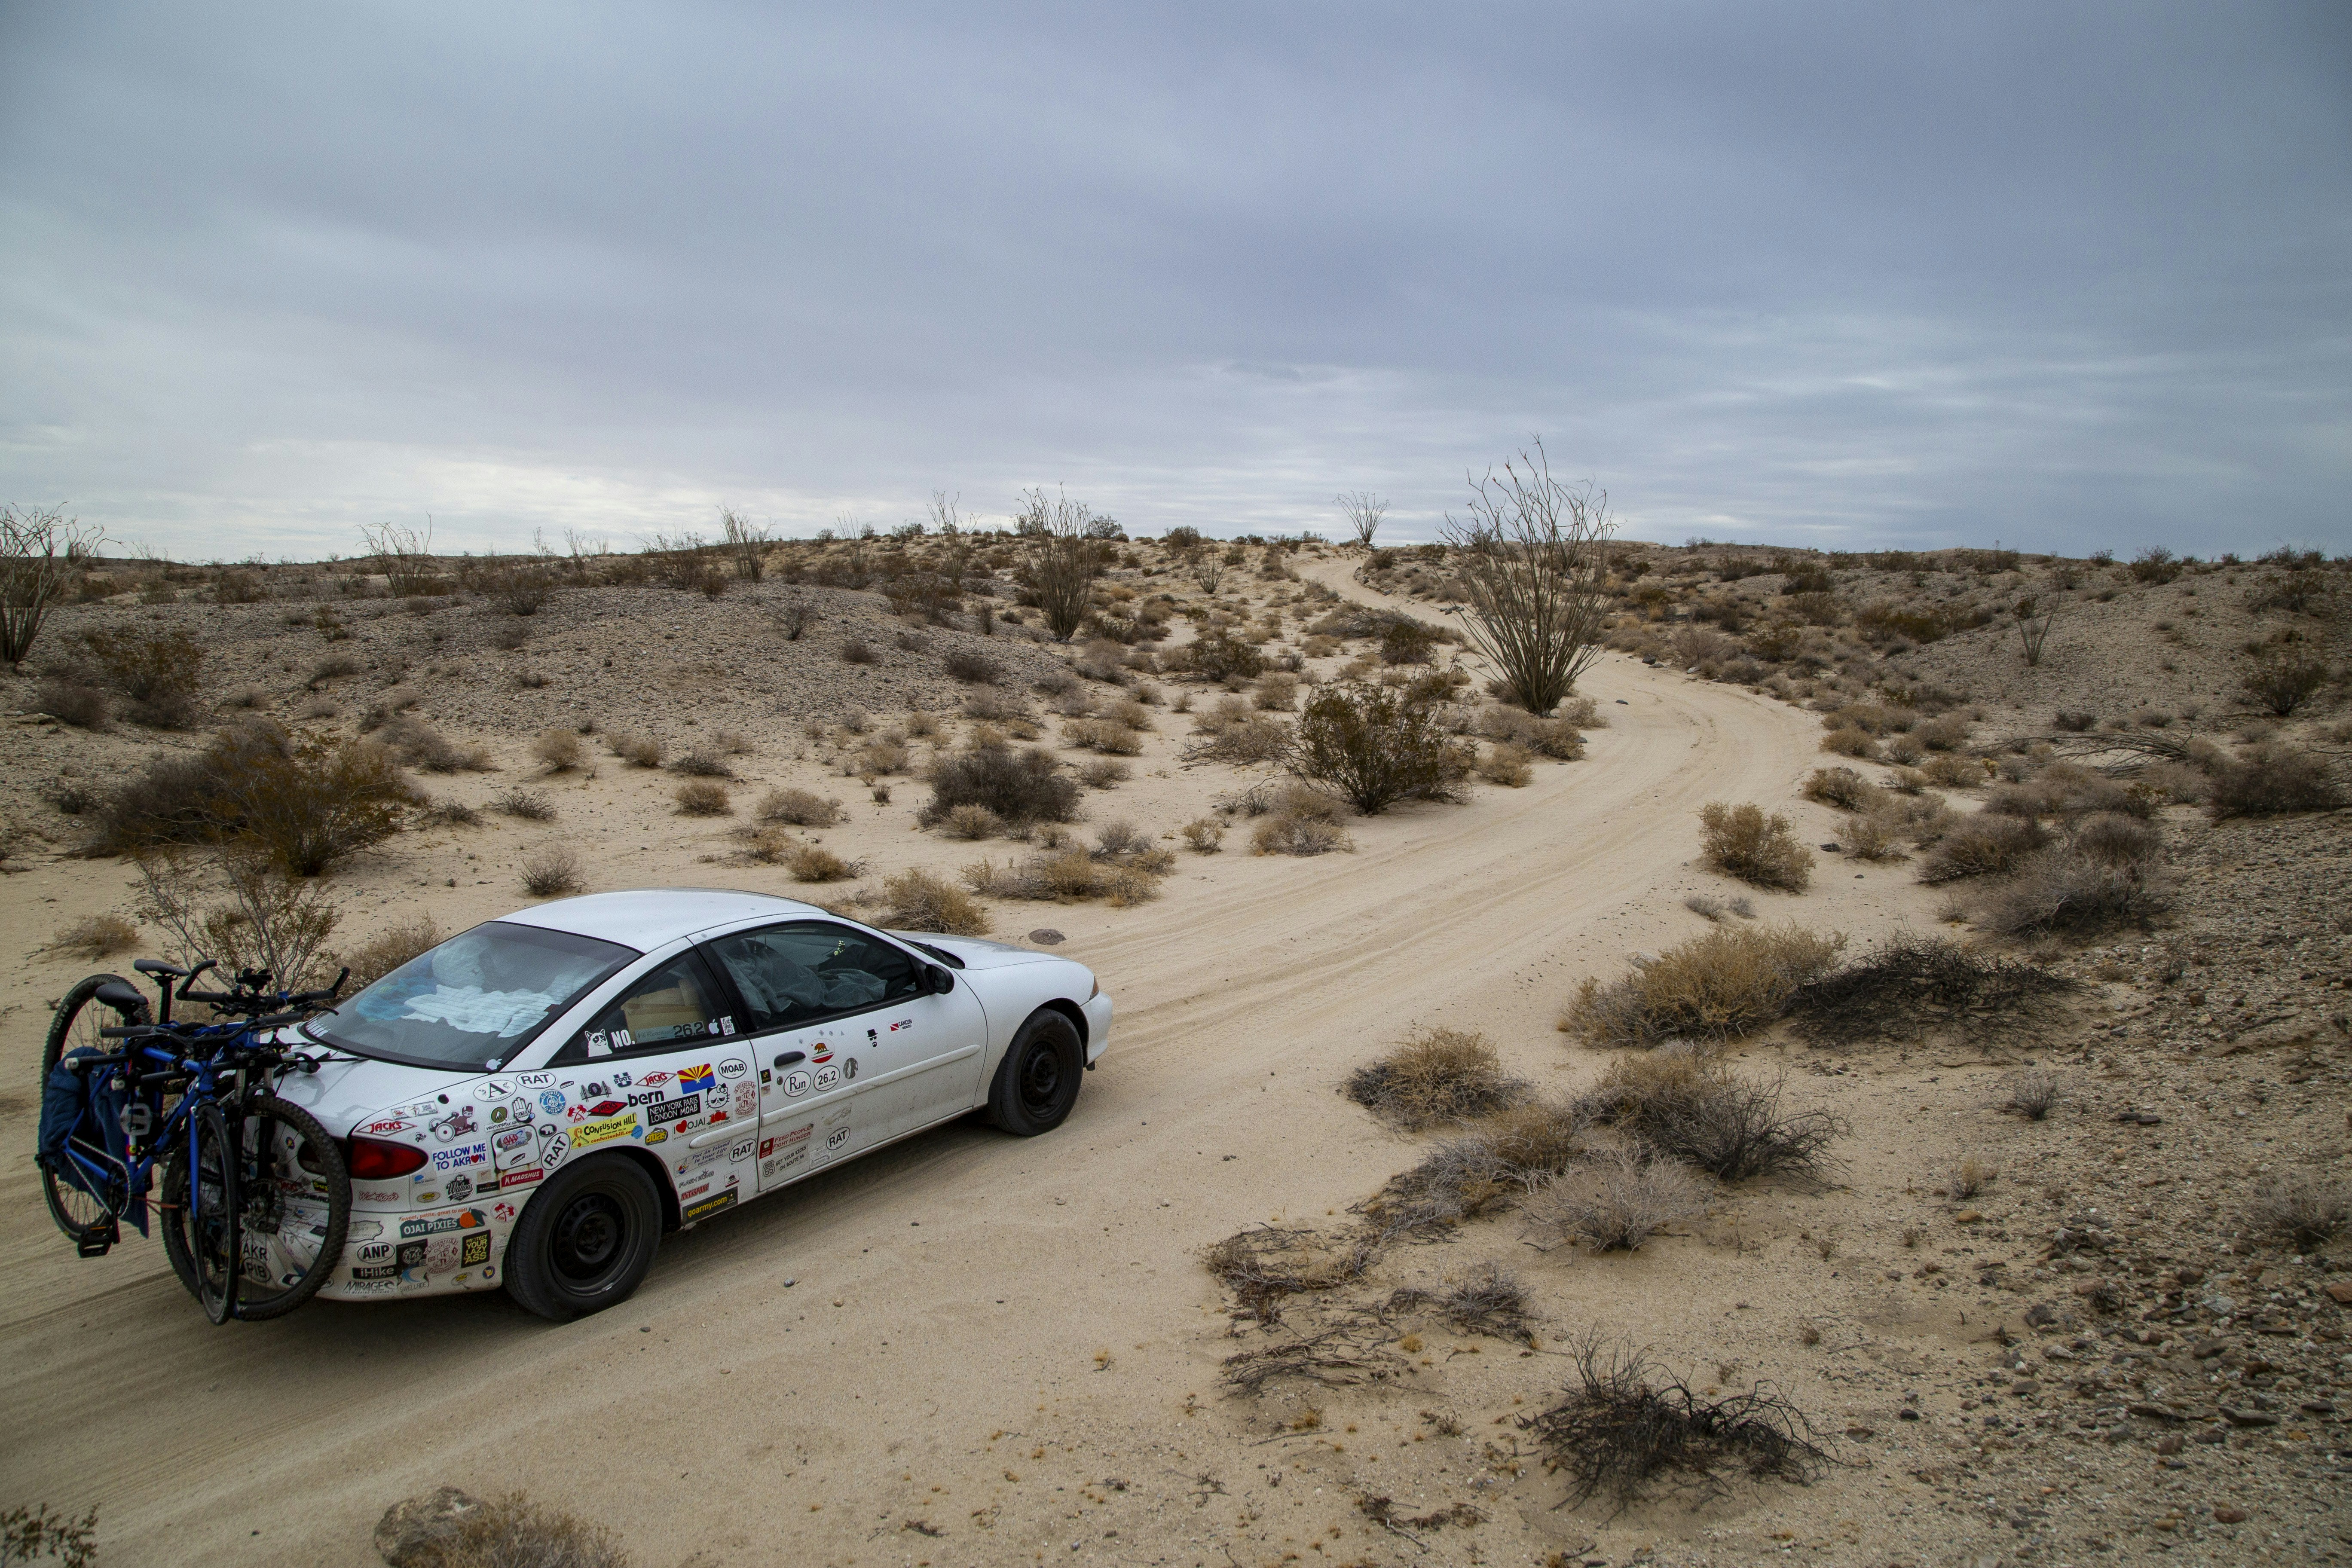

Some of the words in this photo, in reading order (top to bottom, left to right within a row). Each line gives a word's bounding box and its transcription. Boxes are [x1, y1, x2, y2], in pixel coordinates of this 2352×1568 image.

[673, 1022, 703, 1038] 26.2
[898, 1018, 912, 1027] CANCUN
[611, 1030, 635, 1048] NO.
[721, 1064, 744, 1074] MOAB
[520, 1074, 549, 1085] RAT
[614, 1076, 632, 1084] STATE
[789, 1076, 806, 1091] Run
[818, 1070, 836, 1085] 26.2
[488, 1082, 509, 1098] A
[627, 1090, 664, 1107] bern
[649, 1106, 666, 1116] NEW
[667, 1101, 683, 1112] YORK
[683, 1096, 698, 1106] PARIS
[651, 1111, 677, 1123] LONDON
[681, 1104, 698, 1115] MOAB
[584, 1120, 622, 1136] CONFUSION
[624, 1113, 636, 1125] HILL
[687, 1117, 706, 1130] OJAI
[504, 1134, 517, 1145] AAA
[773, 1140, 788, 1149] FIGHT
[789, 1131, 812, 1143] HUNGER.
[774, 1134, 789, 1143] FEED
[829, 1130, 847, 1147] RAT
[433, 1146, 471, 1161] FOLLOW
[473, 1143, 486, 1154] ME
[544, 1136, 566, 1167] RAT
[692, 1151, 703, 1160] Put
[712, 1140, 731, 1153] Island
[702, 1152, 716, 1163] Your
[716, 1146, 728, 1156] Life
[732, 1142, 754, 1159] RAT
[784, 1152, 795, 1161] YOUR
[795, 1145, 807, 1157] KICKS
[436, 1160, 450, 1171] TO
[786, 1158, 799, 1168] ROUTE
[511, 1171, 540, 1183] MADSHUS
[765, 1166, 774, 1176] 66
[688, 1196, 727, 1218] goarmy.com
[404, 1223, 426, 1235] OJAI
[428, 1219, 458, 1232] PIXIES
[466, 1238, 487, 1248] YOUR
[466, 1245, 486, 1256] LAZY
[363, 1244, 390, 1259] ANP
[465, 1252, 486, 1264] ASS
[360, 1266, 395, 1277] iHike
